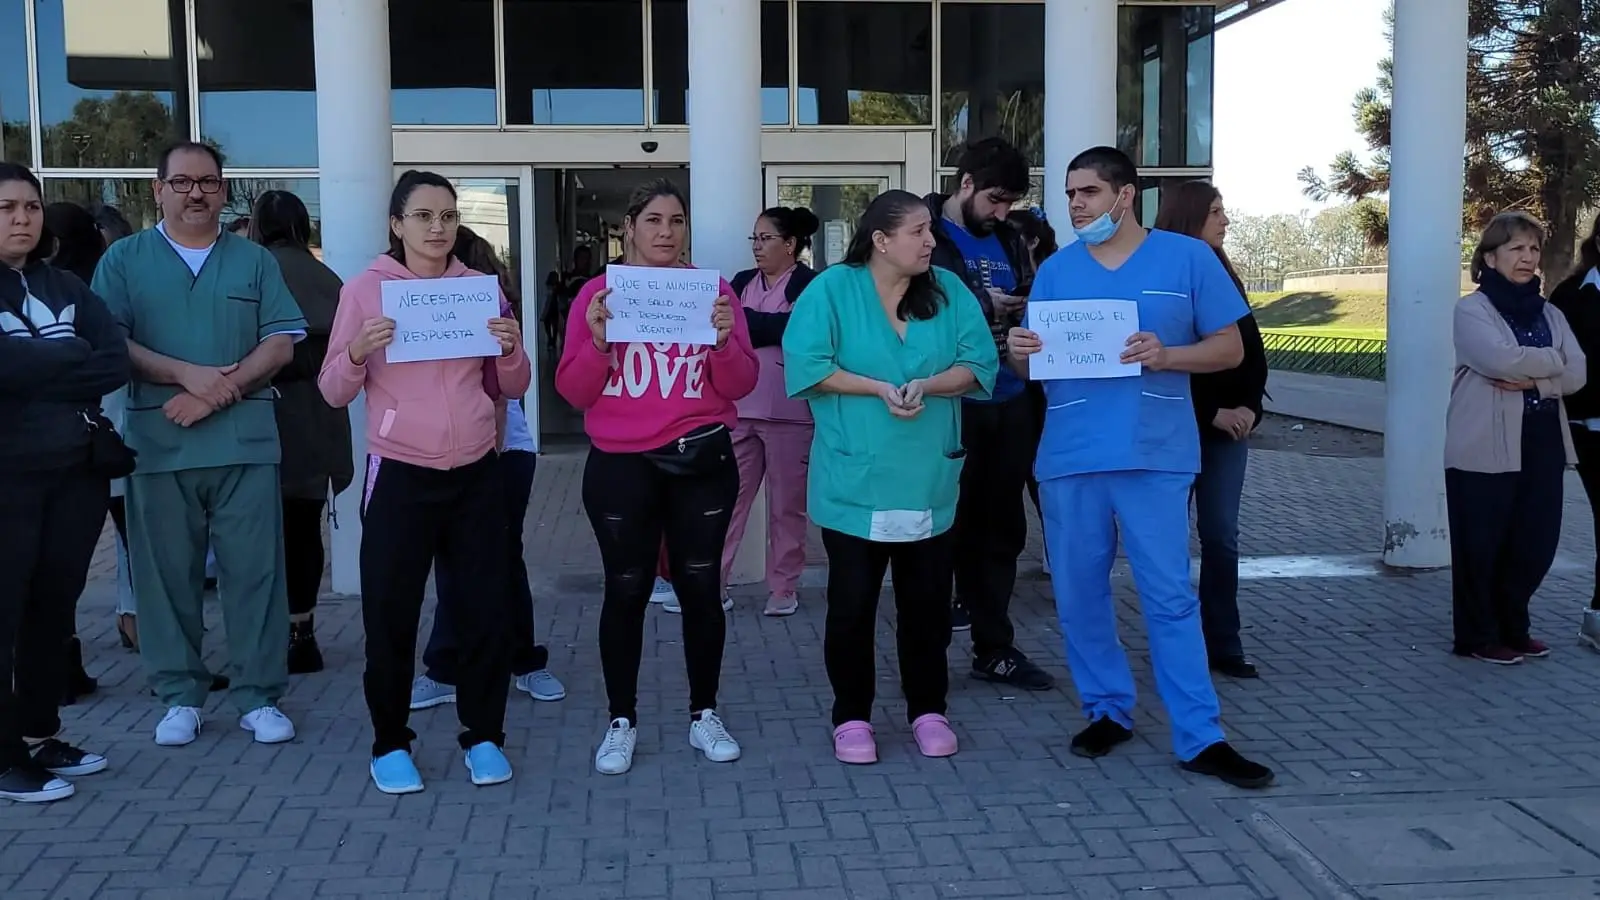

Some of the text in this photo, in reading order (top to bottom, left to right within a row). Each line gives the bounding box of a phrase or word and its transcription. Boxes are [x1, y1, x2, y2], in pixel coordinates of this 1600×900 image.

[615, 274, 640, 292] QUE
[648, 280, 660, 290] EL
[400, 291, 493, 309] NECESITAMOS
[624, 297, 641, 306] DE
[679, 300, 697, 309] NOS
[432, 311, 457, 322] UNA
[1039, 310, 1126, 328] QUEREMOS EL
[401, 330, 475, 343] RESPUESTA
[1065, 331, 1094, 342] PASE
[1047, 353, 1106, 364] A PLANTA
